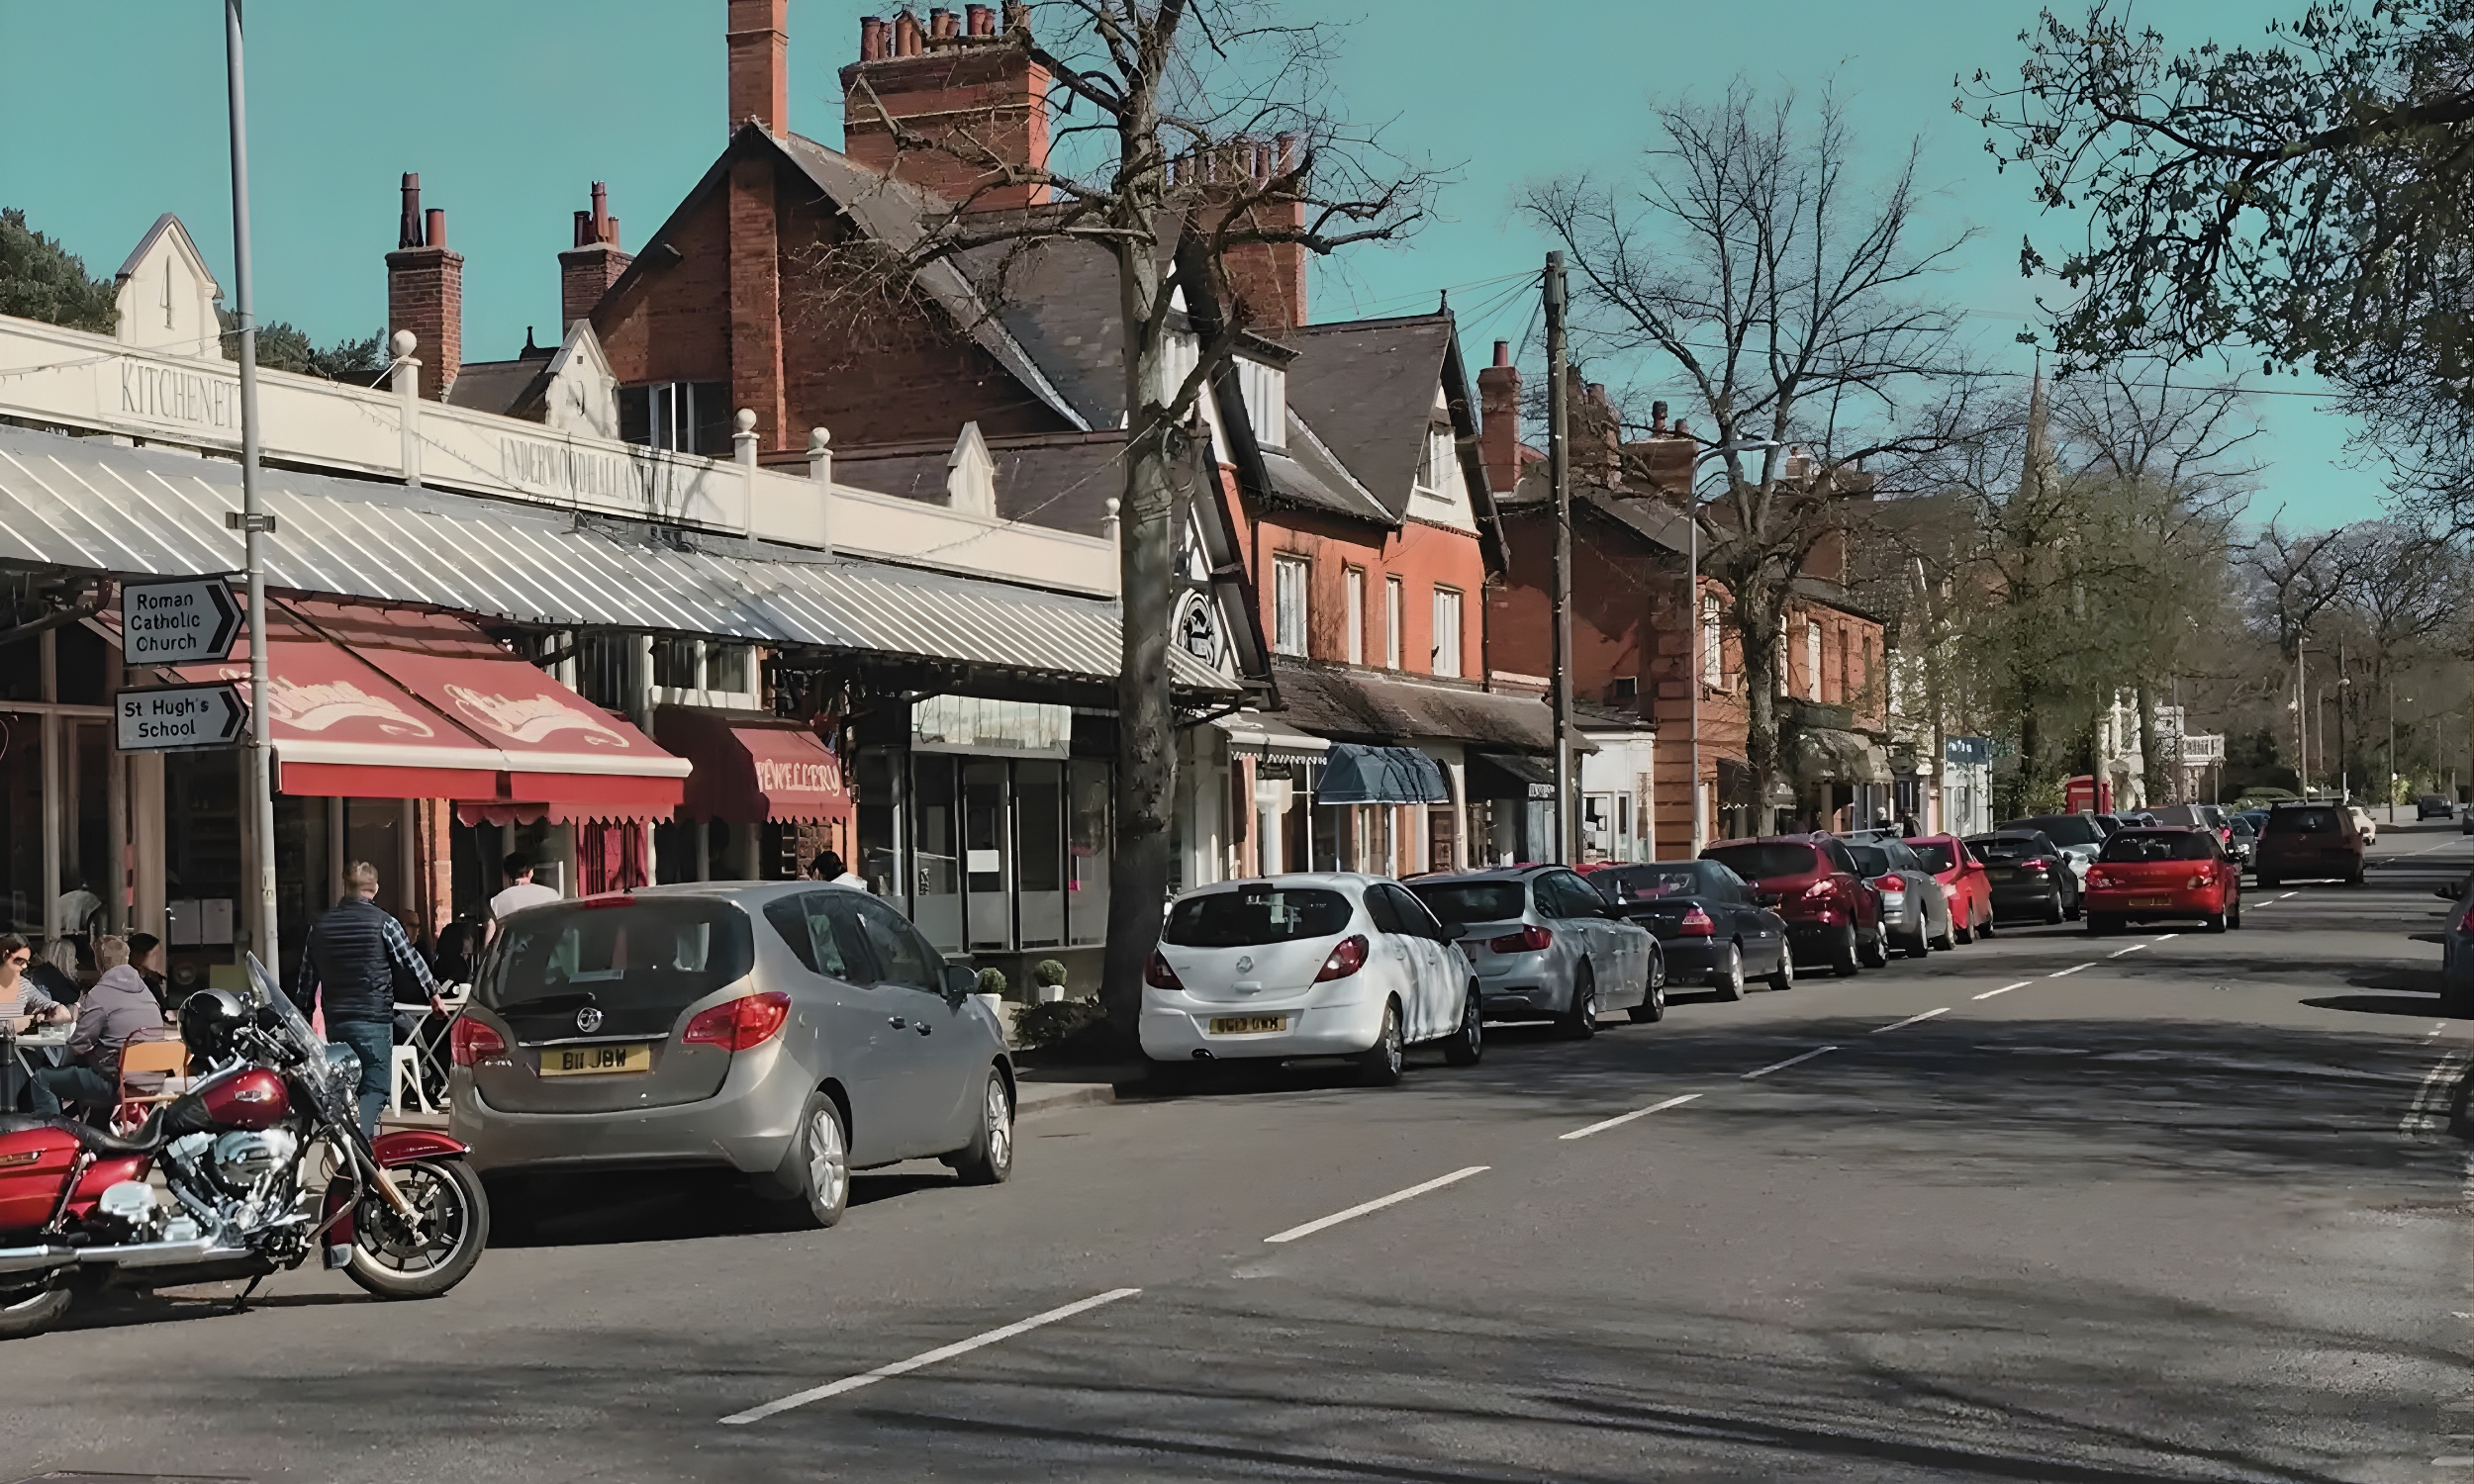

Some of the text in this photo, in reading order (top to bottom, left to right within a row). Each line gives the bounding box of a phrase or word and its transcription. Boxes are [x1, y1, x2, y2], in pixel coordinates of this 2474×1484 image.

[121, 362, 241, 429] KITCHENET
[137, 594, 194, 610] Roman
[131, 611, 201, 631] Catholic
[137, 633, 198, 652] Church
[152, 697, 210, 717] Hugh's
[139, 719, 196, 738] School
